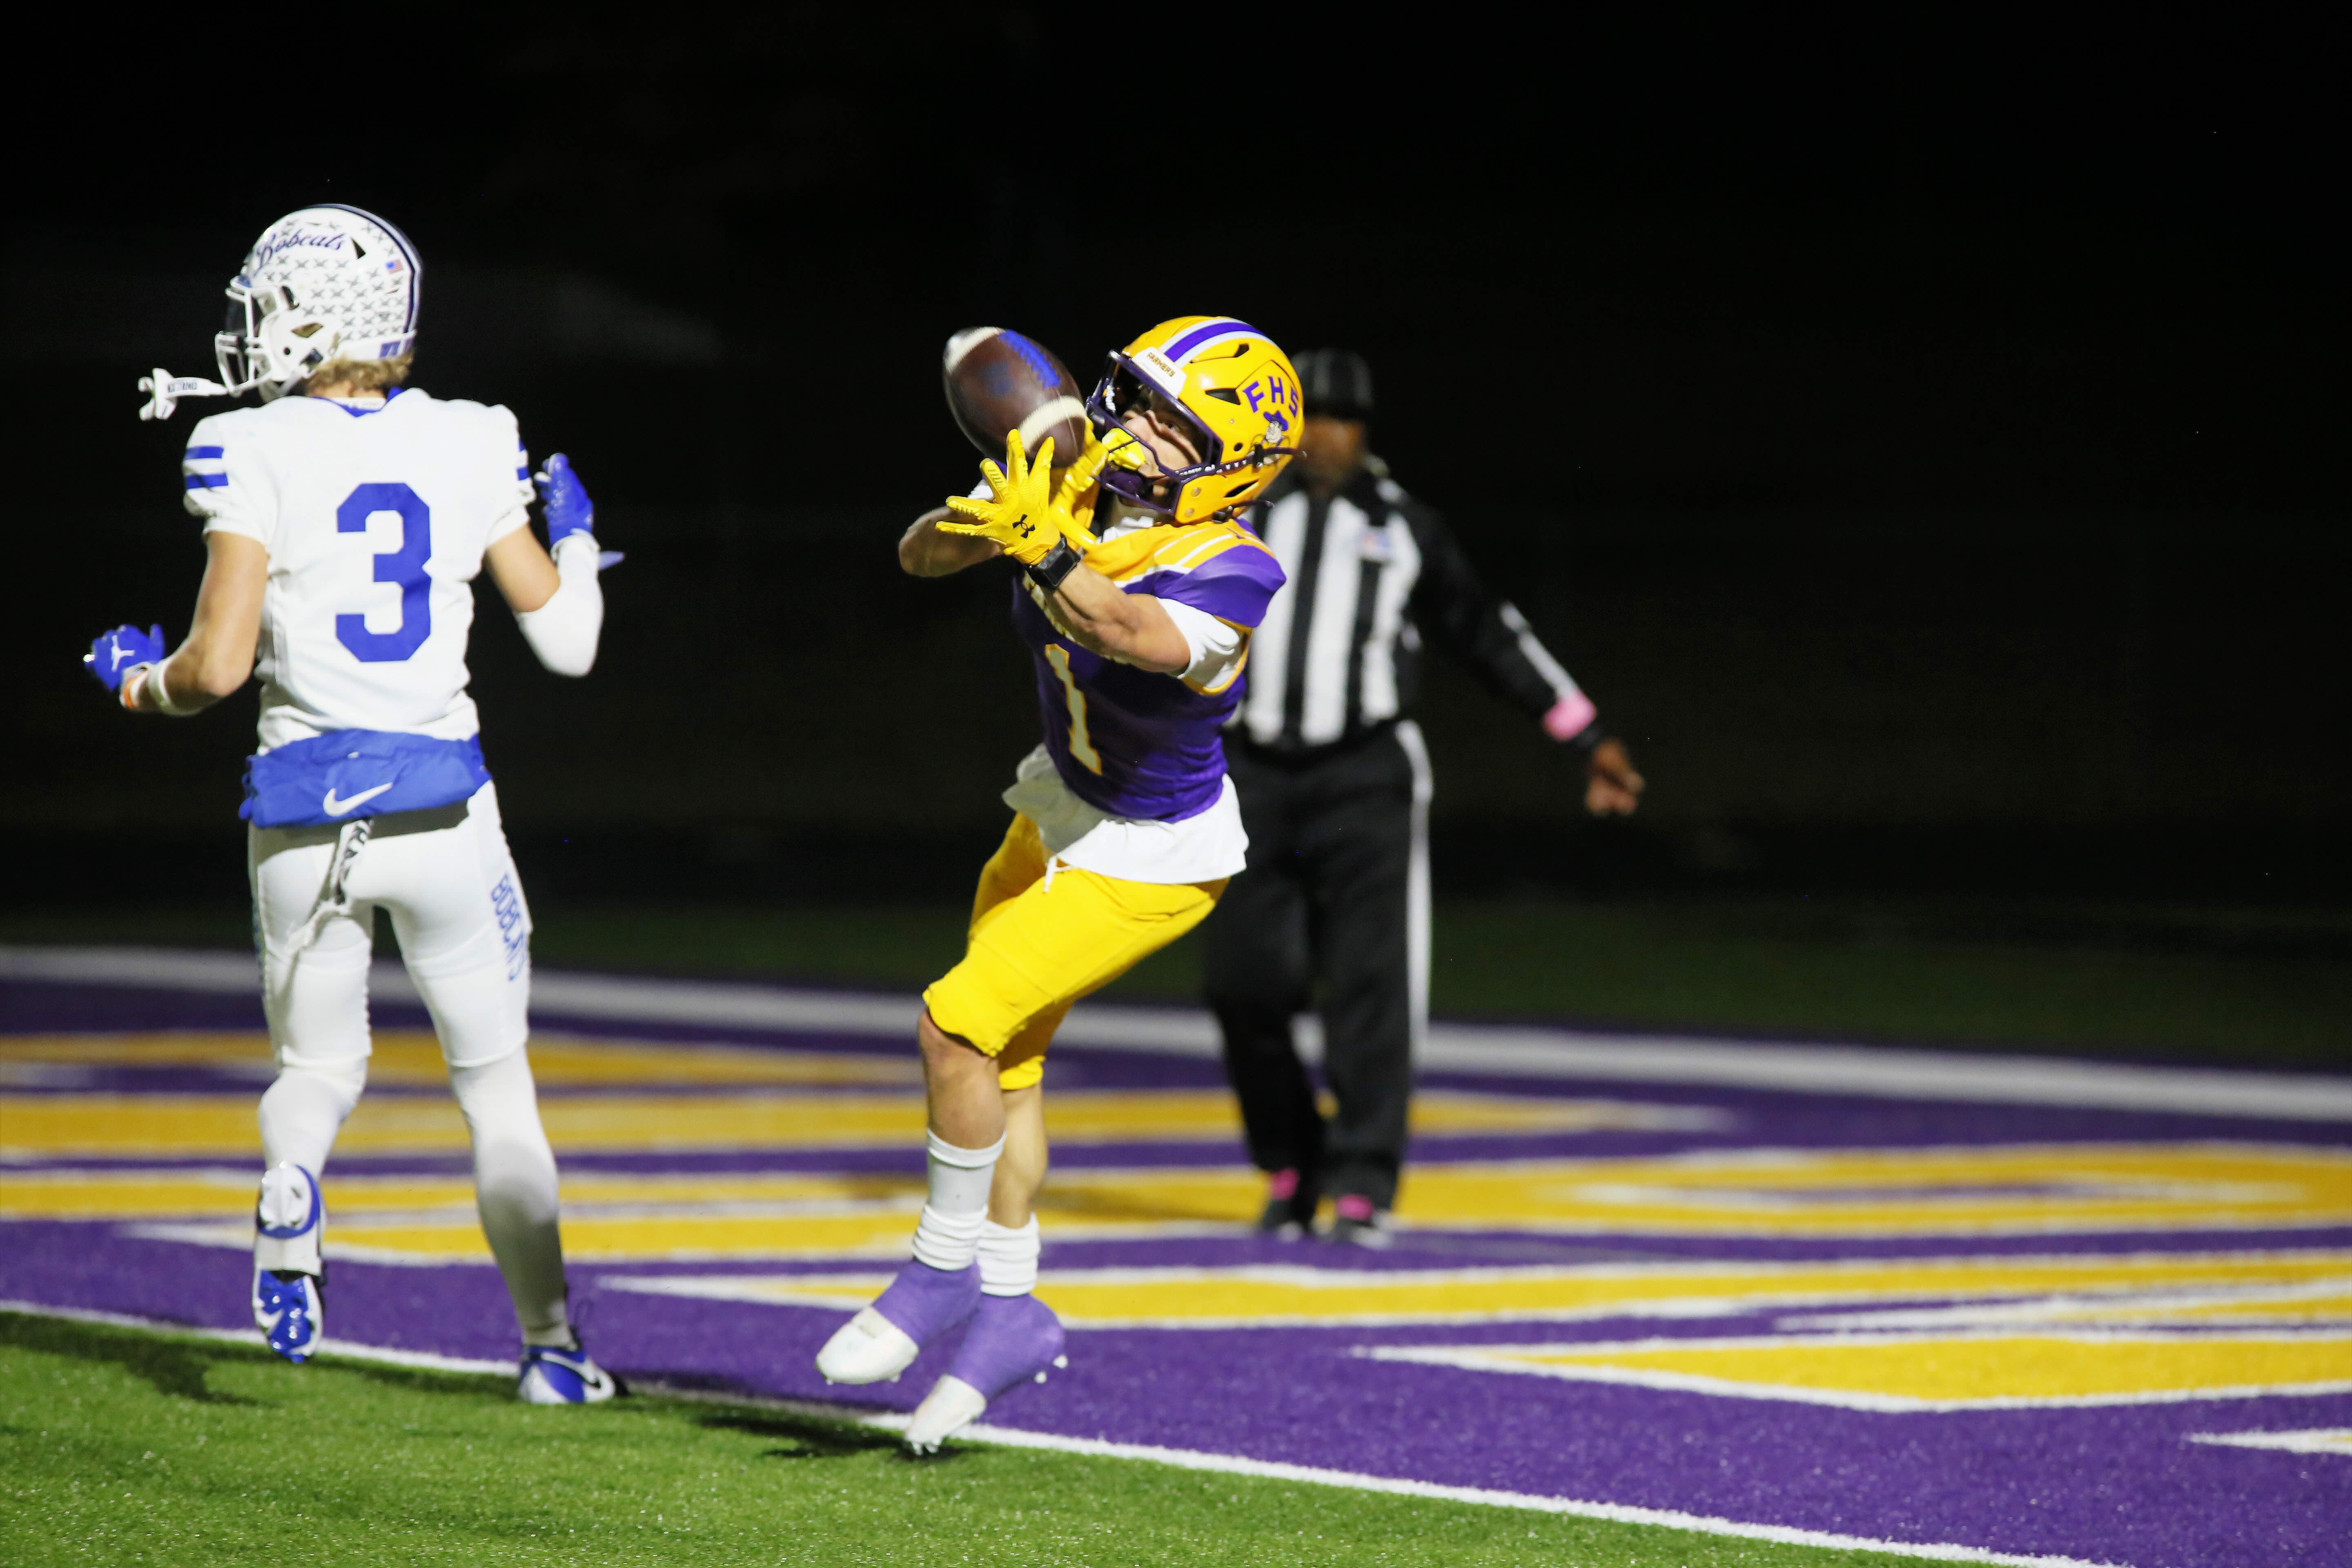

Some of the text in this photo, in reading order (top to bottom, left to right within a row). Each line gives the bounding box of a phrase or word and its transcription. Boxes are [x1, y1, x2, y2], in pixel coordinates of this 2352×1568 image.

[253, 229, 346, 278] Bobcats
[1242, 376, 1299, 418] FHS
[335, 483, 432, 662] 3
[1045, 643, 1102, 775] 1
